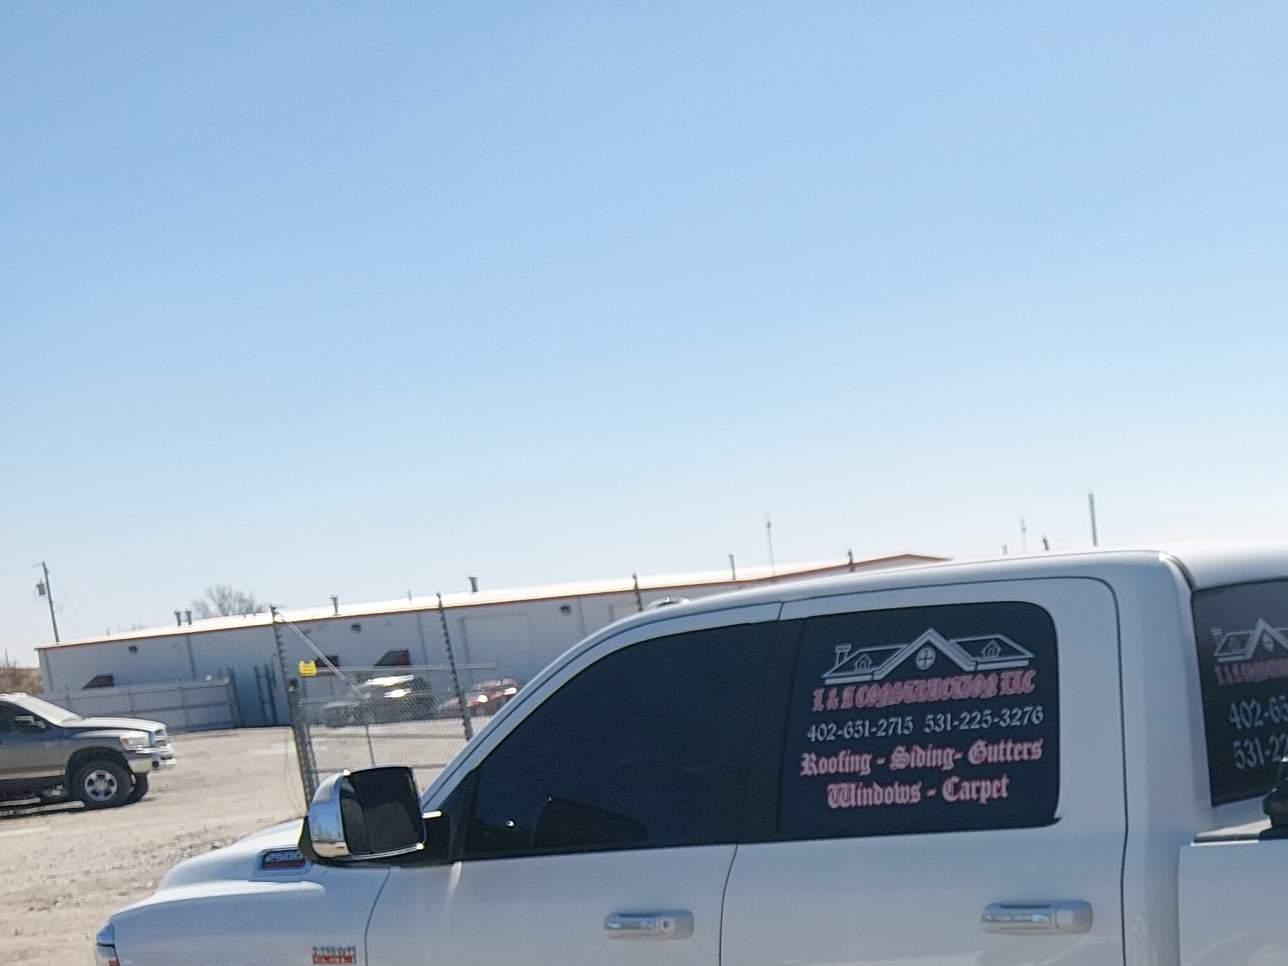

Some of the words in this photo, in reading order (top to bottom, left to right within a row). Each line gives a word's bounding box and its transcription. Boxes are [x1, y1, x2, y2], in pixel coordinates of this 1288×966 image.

[807, 717, 913, 741] 402-651-2715
[924, 705, 1044, 733] 531-225-3276
[800, 750, 872, 776] Roofing
[967, 737, 1044, 765] Gutters
[827, 781, 922, 809] Windows
[942, 773, 1010, 804] Carpet
